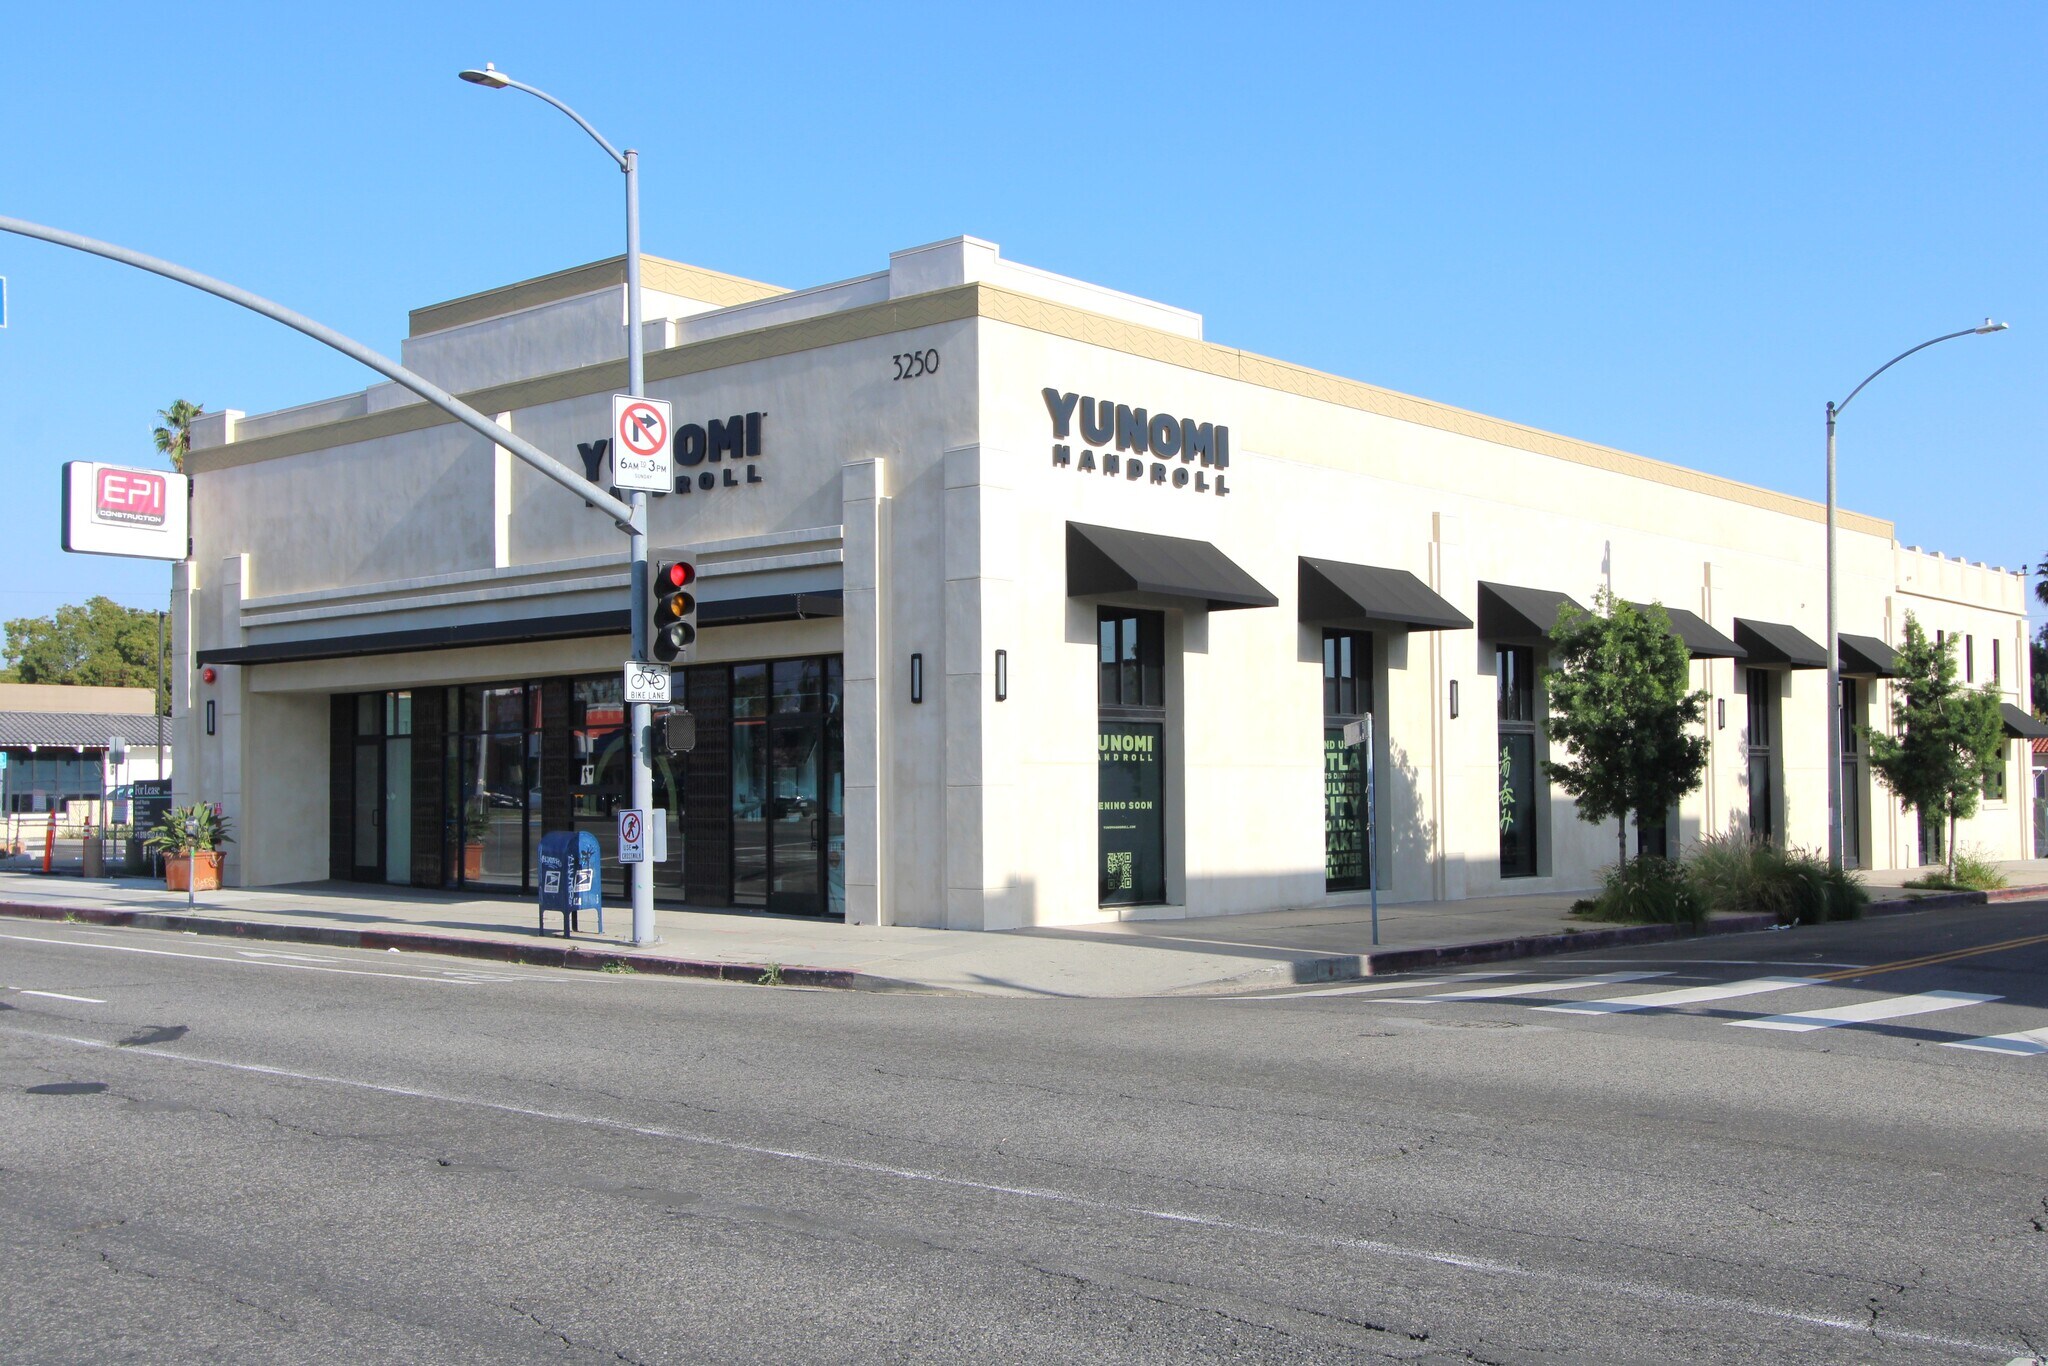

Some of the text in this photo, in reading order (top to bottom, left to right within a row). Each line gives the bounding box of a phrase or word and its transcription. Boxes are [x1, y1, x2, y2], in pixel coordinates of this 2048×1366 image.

[892, 348, 939, 381] 3250
[1041, 387, 1230, 471] YUNOMI
[577, 411, 762, 482] YOMI
[620, 457, 640, 470] 6AM
[648, 459, 667, 473] 3PM
[1052, 444, 1230, 497] HANDROLL
[103, 475, 160, 508] EPI
[99, 510, 162, 523] CONSTRUCTION
[630, 691, 665, 700] BIKE LANE
[135, 784, 143, 795] For
[144, 784, 160, 795] Lease
[1128, 801, 1153, 810] SOON
[623, 844, 632, 852] USE
